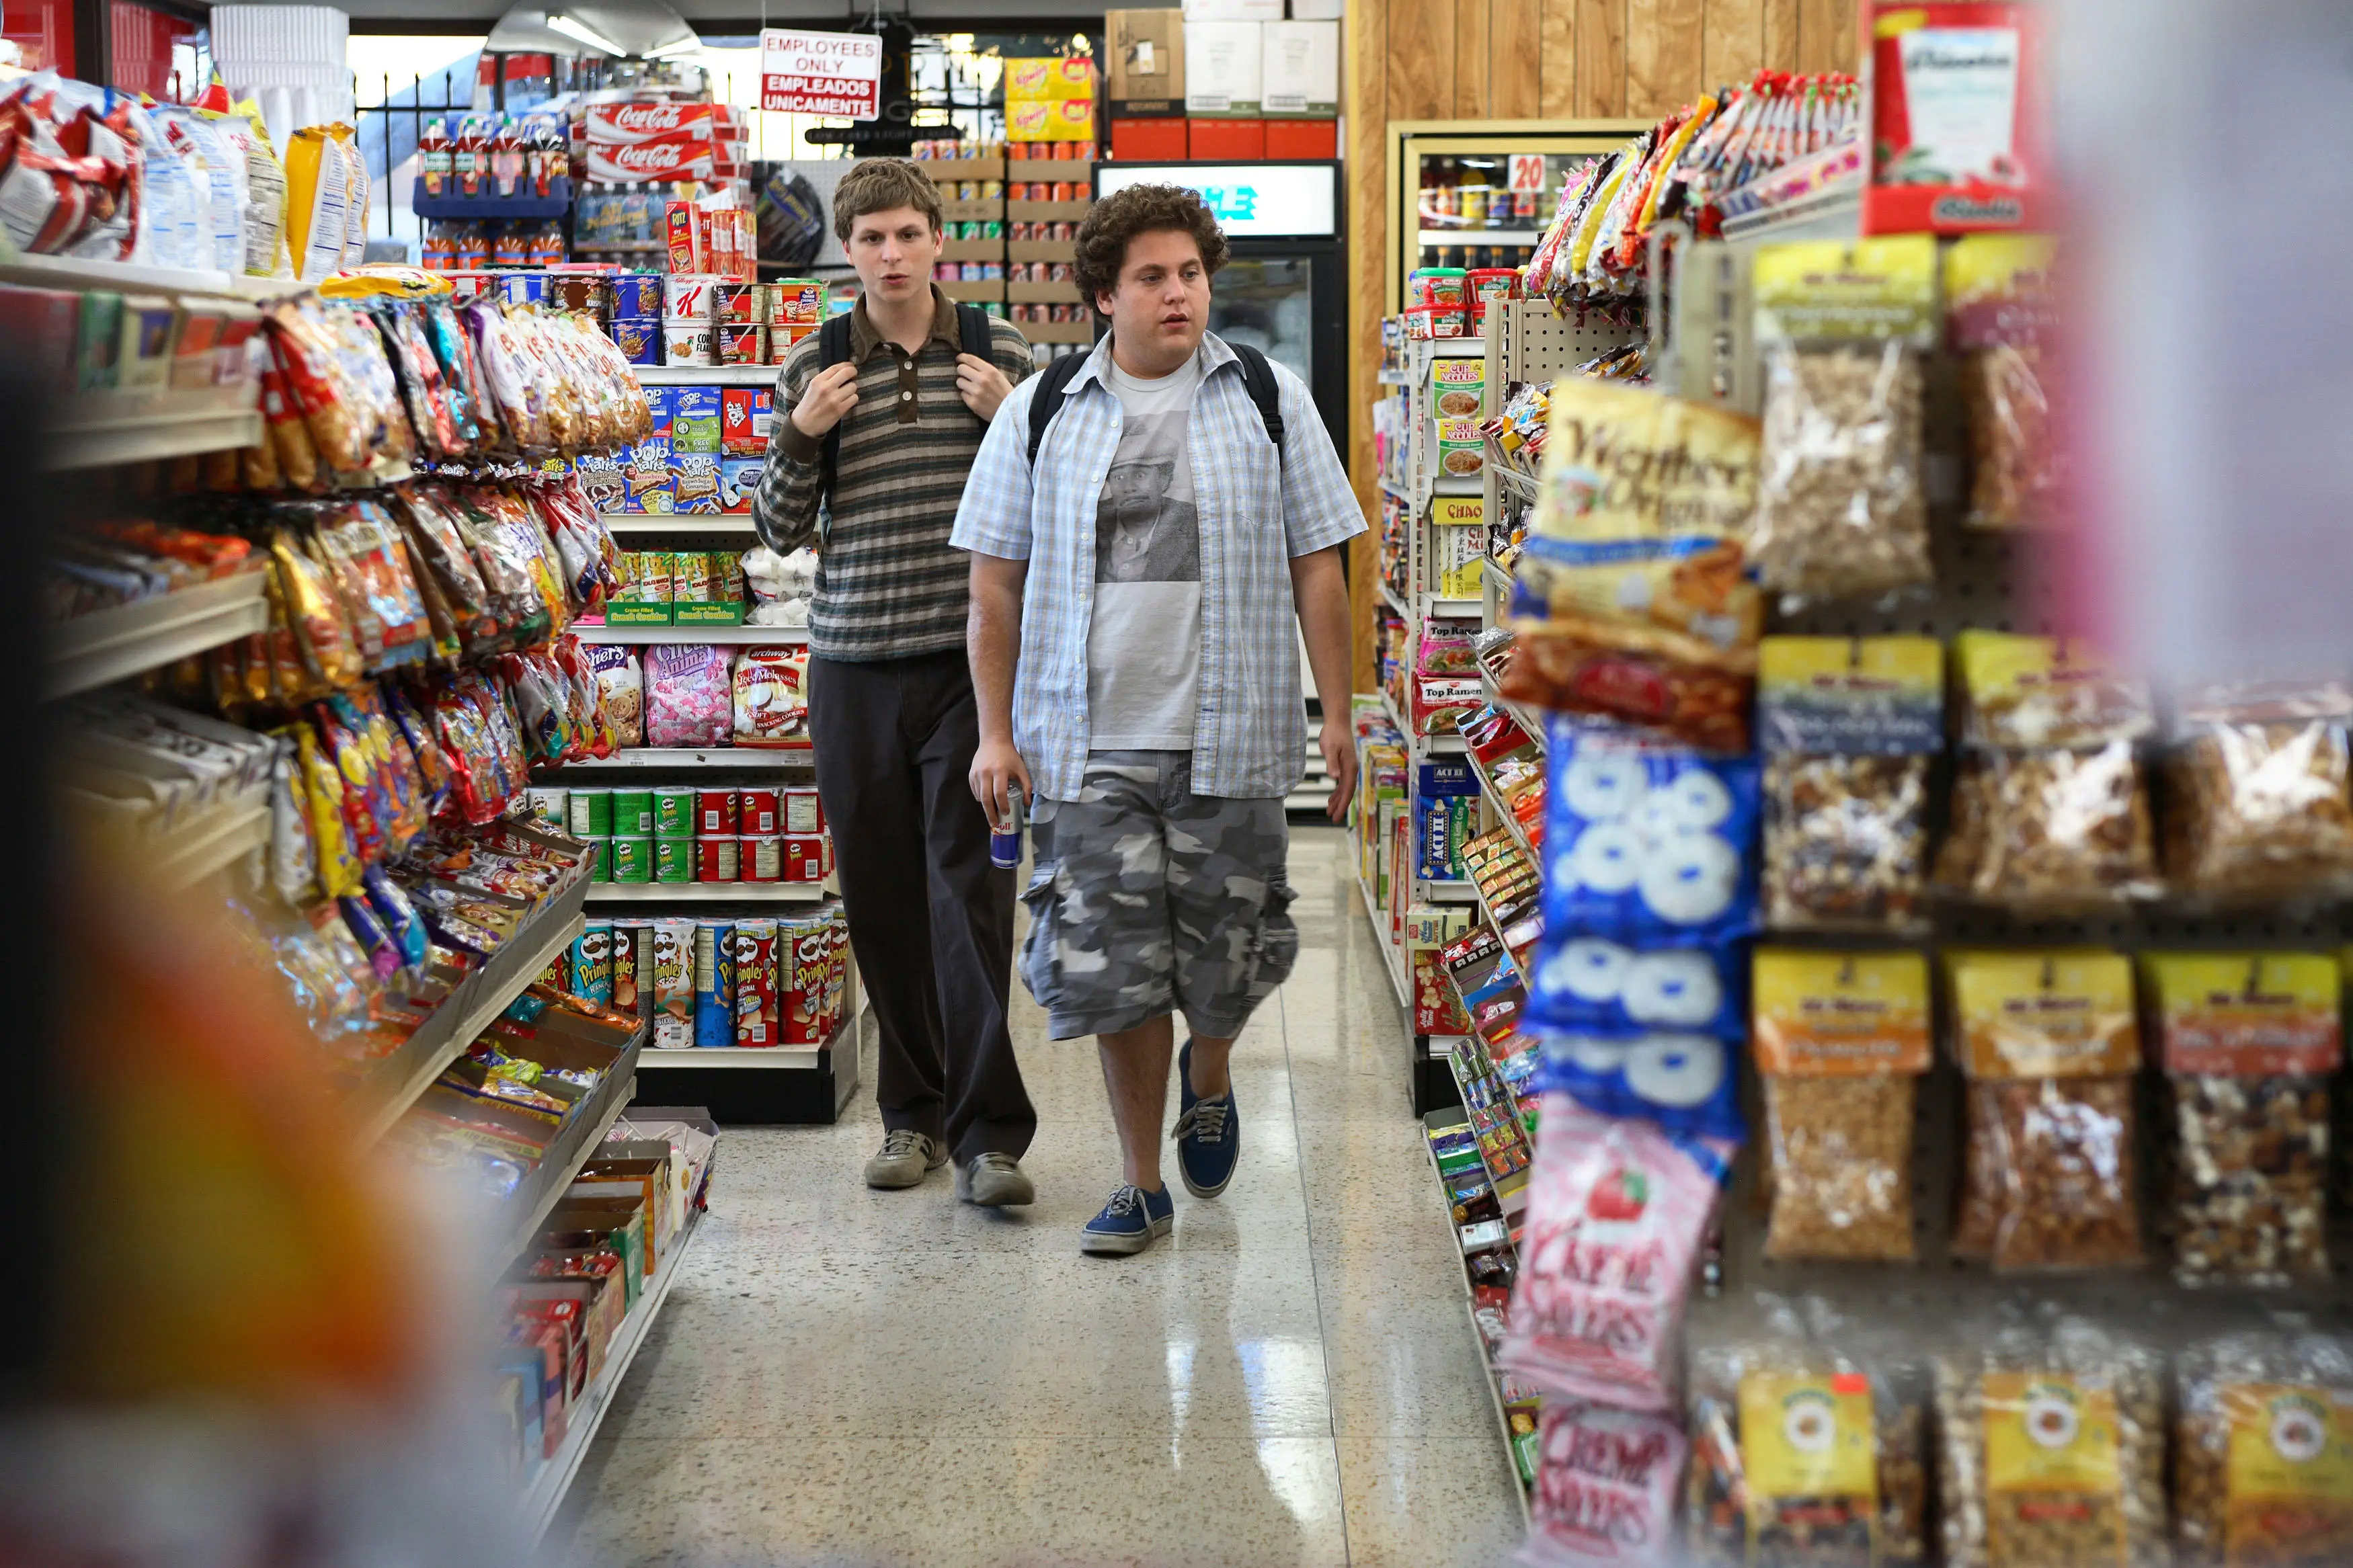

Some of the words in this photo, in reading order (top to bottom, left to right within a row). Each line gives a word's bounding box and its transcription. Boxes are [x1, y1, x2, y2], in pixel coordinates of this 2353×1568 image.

[767, 38, 875, 58] EMPLOYEES
[796, 58, 844, 73] ONLY
[767, 75, 871, 97] EMPLEADOS
[764, 94, 873, 117] UNICAMENTE
[1515, 155, 1542, 189] 20
[672, 212, 686, 226] RITZ
[676, 286, 702, 317] K
[1449, 364, 1471, 374] CUP
[1441, 372, 1478, 382] NOODLES
[1454, 423, 1475, 431] CUP
[588, 459, 618, 472] tarts
[636, 460, 667, 473] tarts
[686, 466, 711, 478] tarts
[581, 472, 608, 480] Chocolate
[608, 470, 623, 480] Chip
[604, 477, 623, 485] Dough
[698, 479, 713, 487] Sugar
[1447, 504, 1483, 519] CHAO
[656, 577, 670, 585] MARCH
[611, 612, 635, 622] Snack
[636, 612, 668, 622] Cookies
[678, 611, 703, 620] Snack
[703, 610, 735, 620] Cookies
[1430, 627, 1449, 636] Top
[750, 649, 791, 659] archway
[758, 669, 797, 684] Molasses
[1425, 688, 1445, 698] Top
[1446, 687, 1482, 696] Ramen
[782, 709, 805, 721] COOKIES
[756, 716, 783, 729] SNACKING
[1454, 807, 1464, 821] Corn
[1433, 817, 1445, 832] II
[1432, 833, 1445, 860] ACT
[745, 995, 760, 1004] WIN
[1419, 1009, 1429, 1028] Jolly
